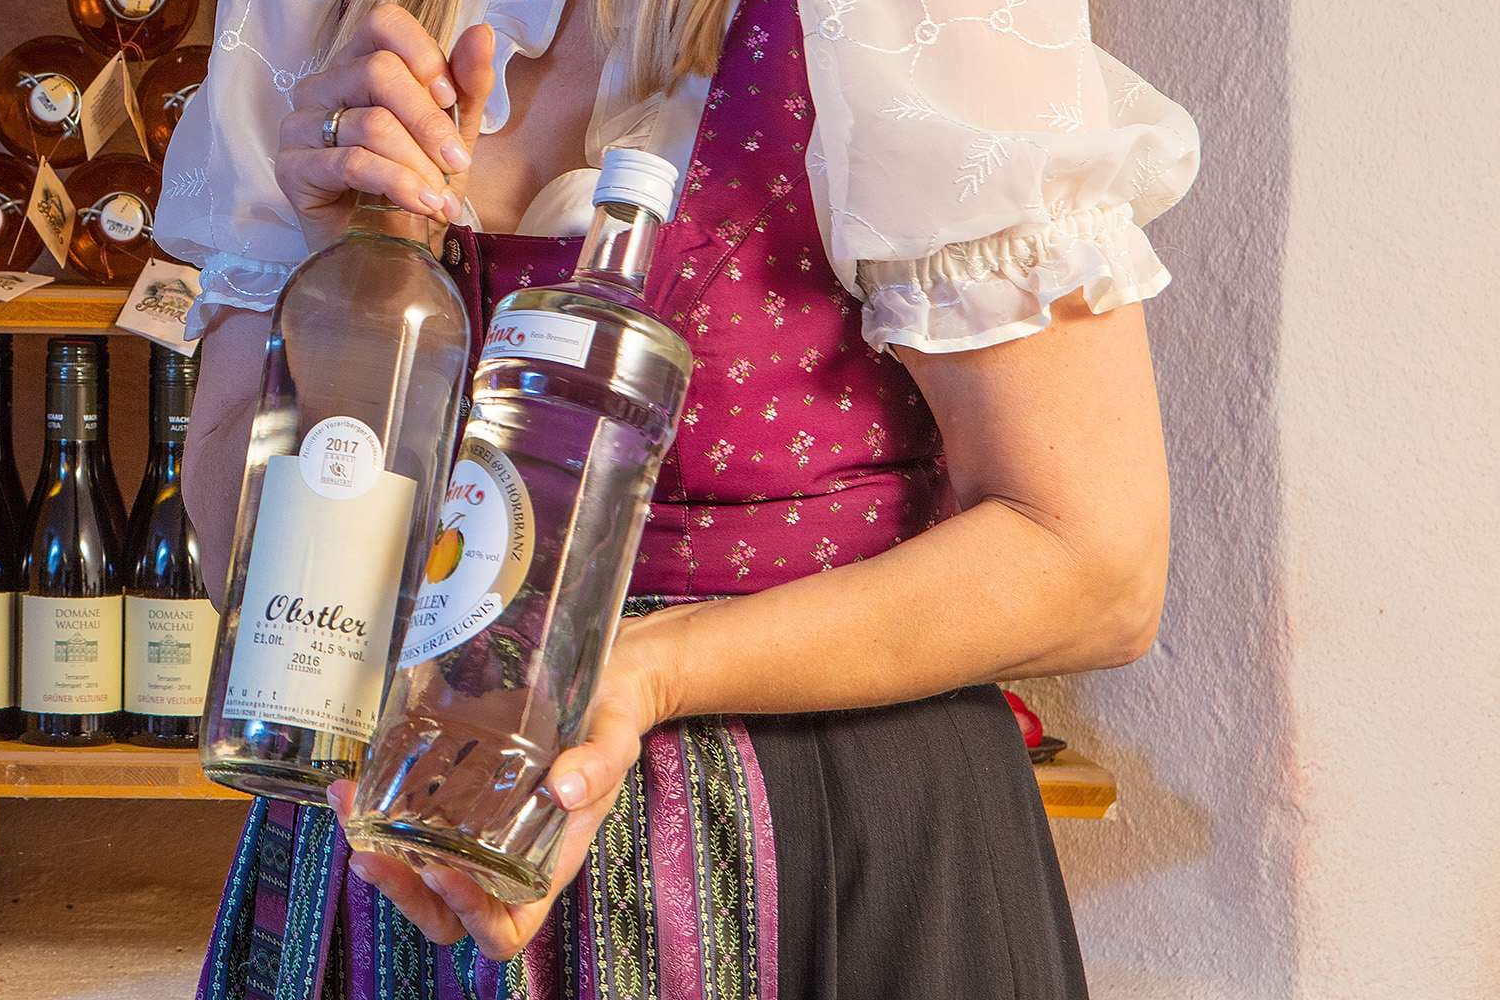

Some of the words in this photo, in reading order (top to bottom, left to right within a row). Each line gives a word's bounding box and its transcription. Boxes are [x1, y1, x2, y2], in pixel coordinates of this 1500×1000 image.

[325, 437, 360, 455] 2017
[492, 458, 511, 484] 6912
[505, 481, 526, 562] HÖRBRANZ
[55, 607, 101, 619] DOMÄNE
[148, 608, 195, 620] DOMÄNE
[264, 593, 368, 638] Obstler
[55, 619, 101, 630] WACHAU
[148, 621, 195, 632] WACHAU
[422, 599, 496, 650] ERZEUGNIS
[291, 651, 322, 668] 2016
[337, 645, 347, 658] %
[348, 649, 366, 663] vol.
[42, 693, 73, 703] GRÜNER
[227, 685, 278, 702] Kurt
[323, 698, 377, 723] Fink
